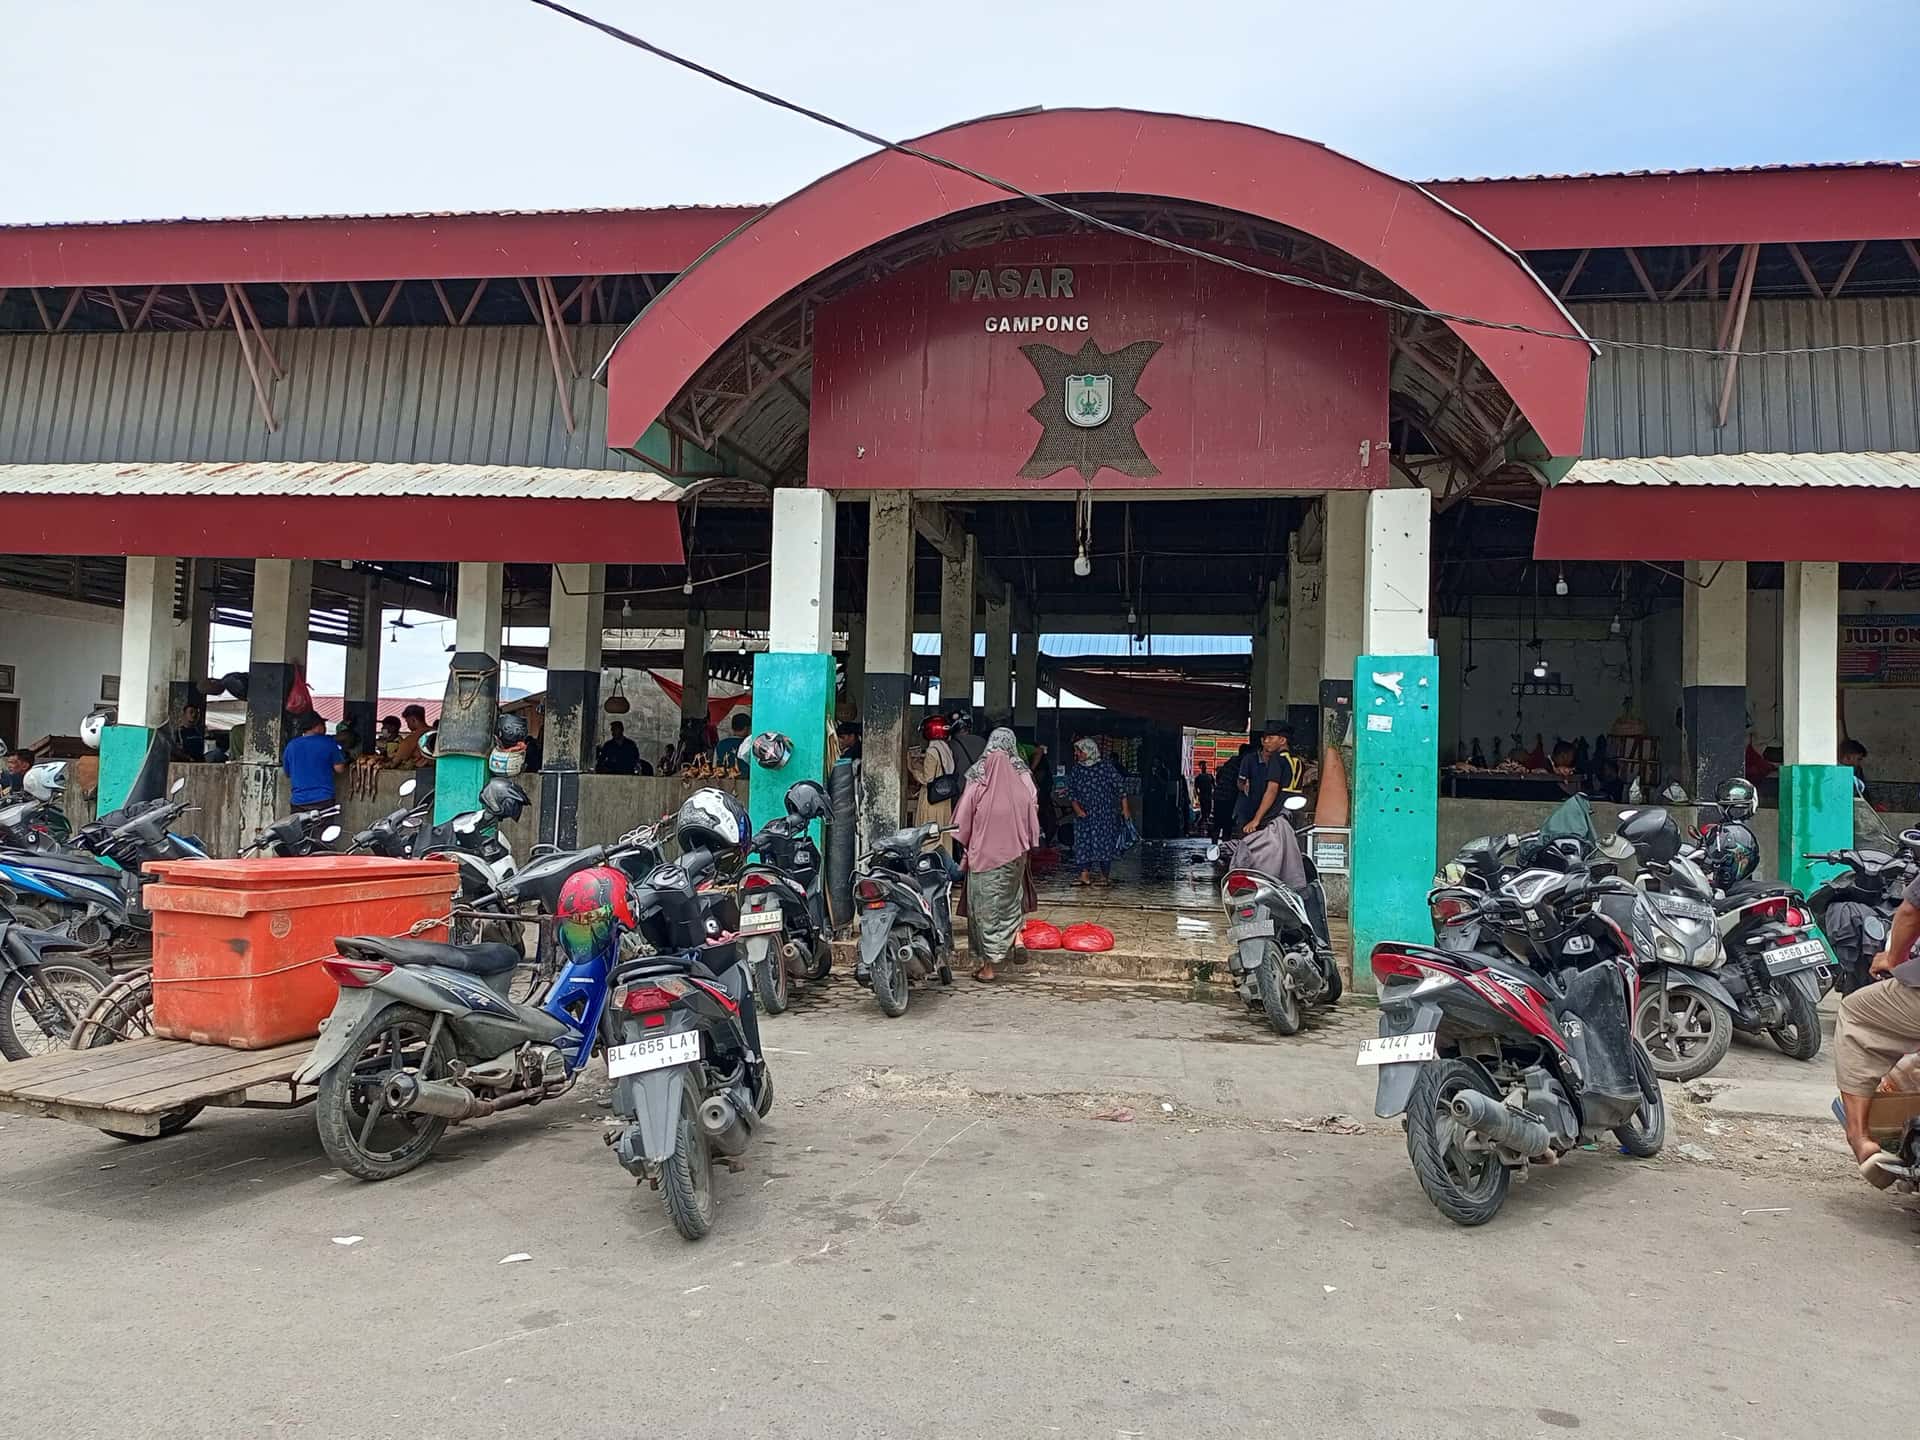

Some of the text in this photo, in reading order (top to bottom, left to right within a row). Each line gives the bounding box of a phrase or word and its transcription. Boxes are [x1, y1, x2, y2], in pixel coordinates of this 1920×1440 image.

[950, 268, 1075, 299] PASAR
[985, 315, 1089, 332] GAMPONG
[1844, 628, 1889, 643] JUDI
[609, 1032, 697, 1062] BL 4655 LAY
[1360, 1033, 1434, 1052] BL 4747 JV
